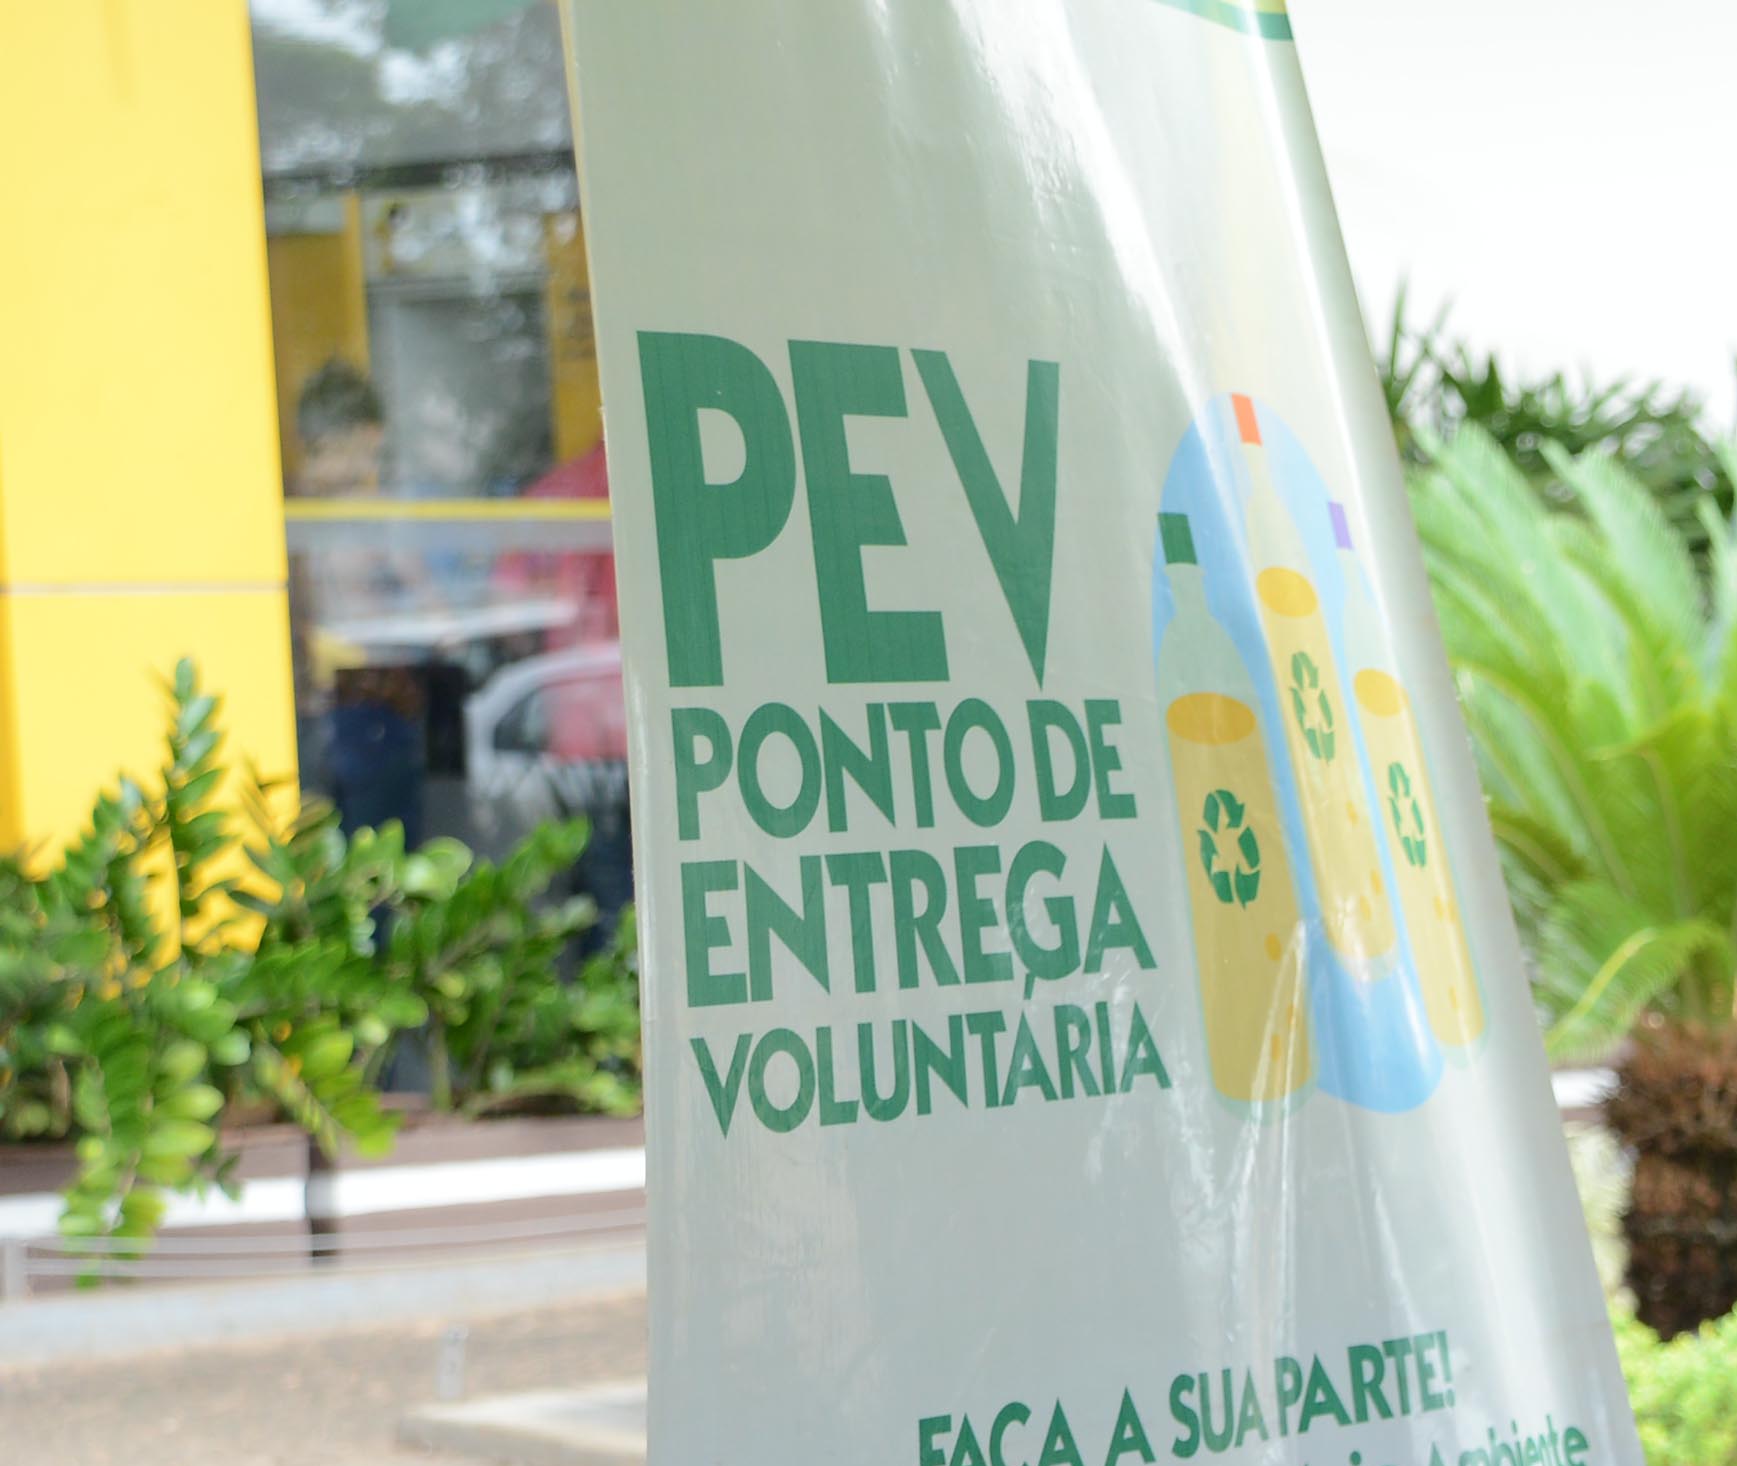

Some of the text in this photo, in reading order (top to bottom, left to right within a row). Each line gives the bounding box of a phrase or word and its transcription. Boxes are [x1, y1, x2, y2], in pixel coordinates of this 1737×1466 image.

[636, 330, 1060, 690] PEV
[670, 697, 1138, 841] PONTO DE
[680, 840, 1157, 1008] ENTREGA
[689, 976, 1173, 1140] VOLUNTÁRIA
[1168, 1365, 1270, 1459] SUA
[1274, 1329, 1456, 1437] PARTE!
